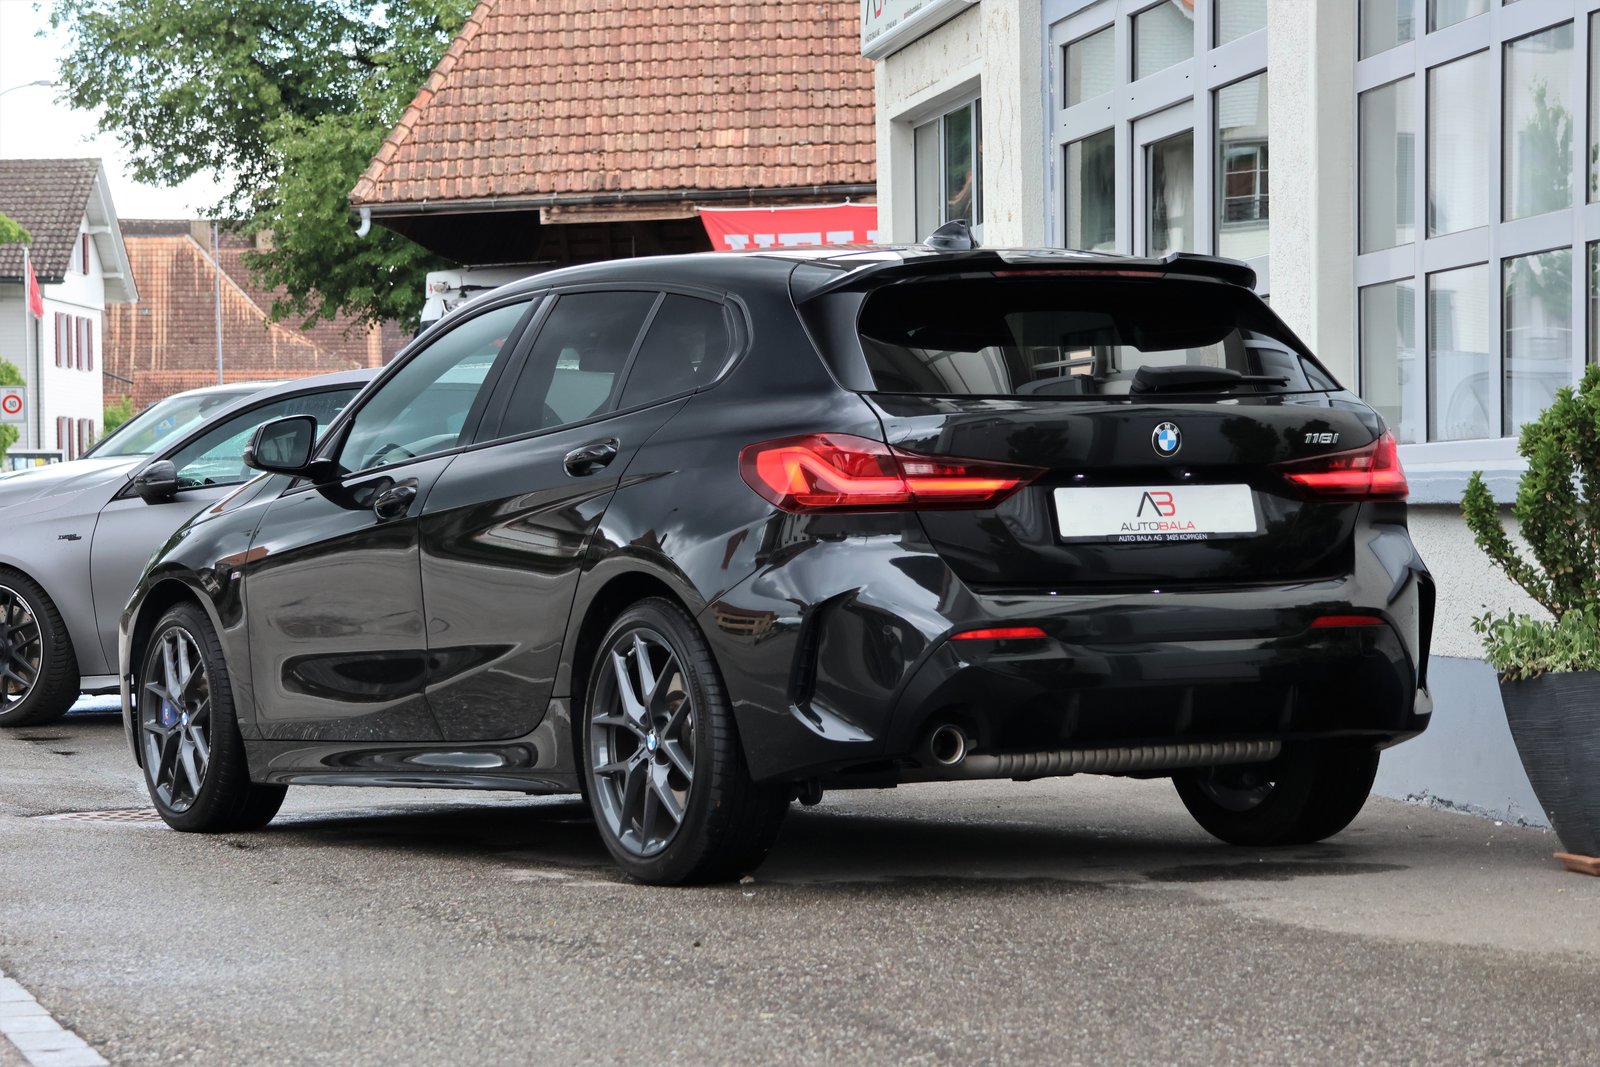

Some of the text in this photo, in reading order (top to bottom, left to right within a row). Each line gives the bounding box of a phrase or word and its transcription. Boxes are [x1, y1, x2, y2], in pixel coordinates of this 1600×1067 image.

[1120, 520, 1196, 532] AUTOBALA
[1118, 534, 1136, 542] AUTO
[1136, 534, 1153, 542] BALA
